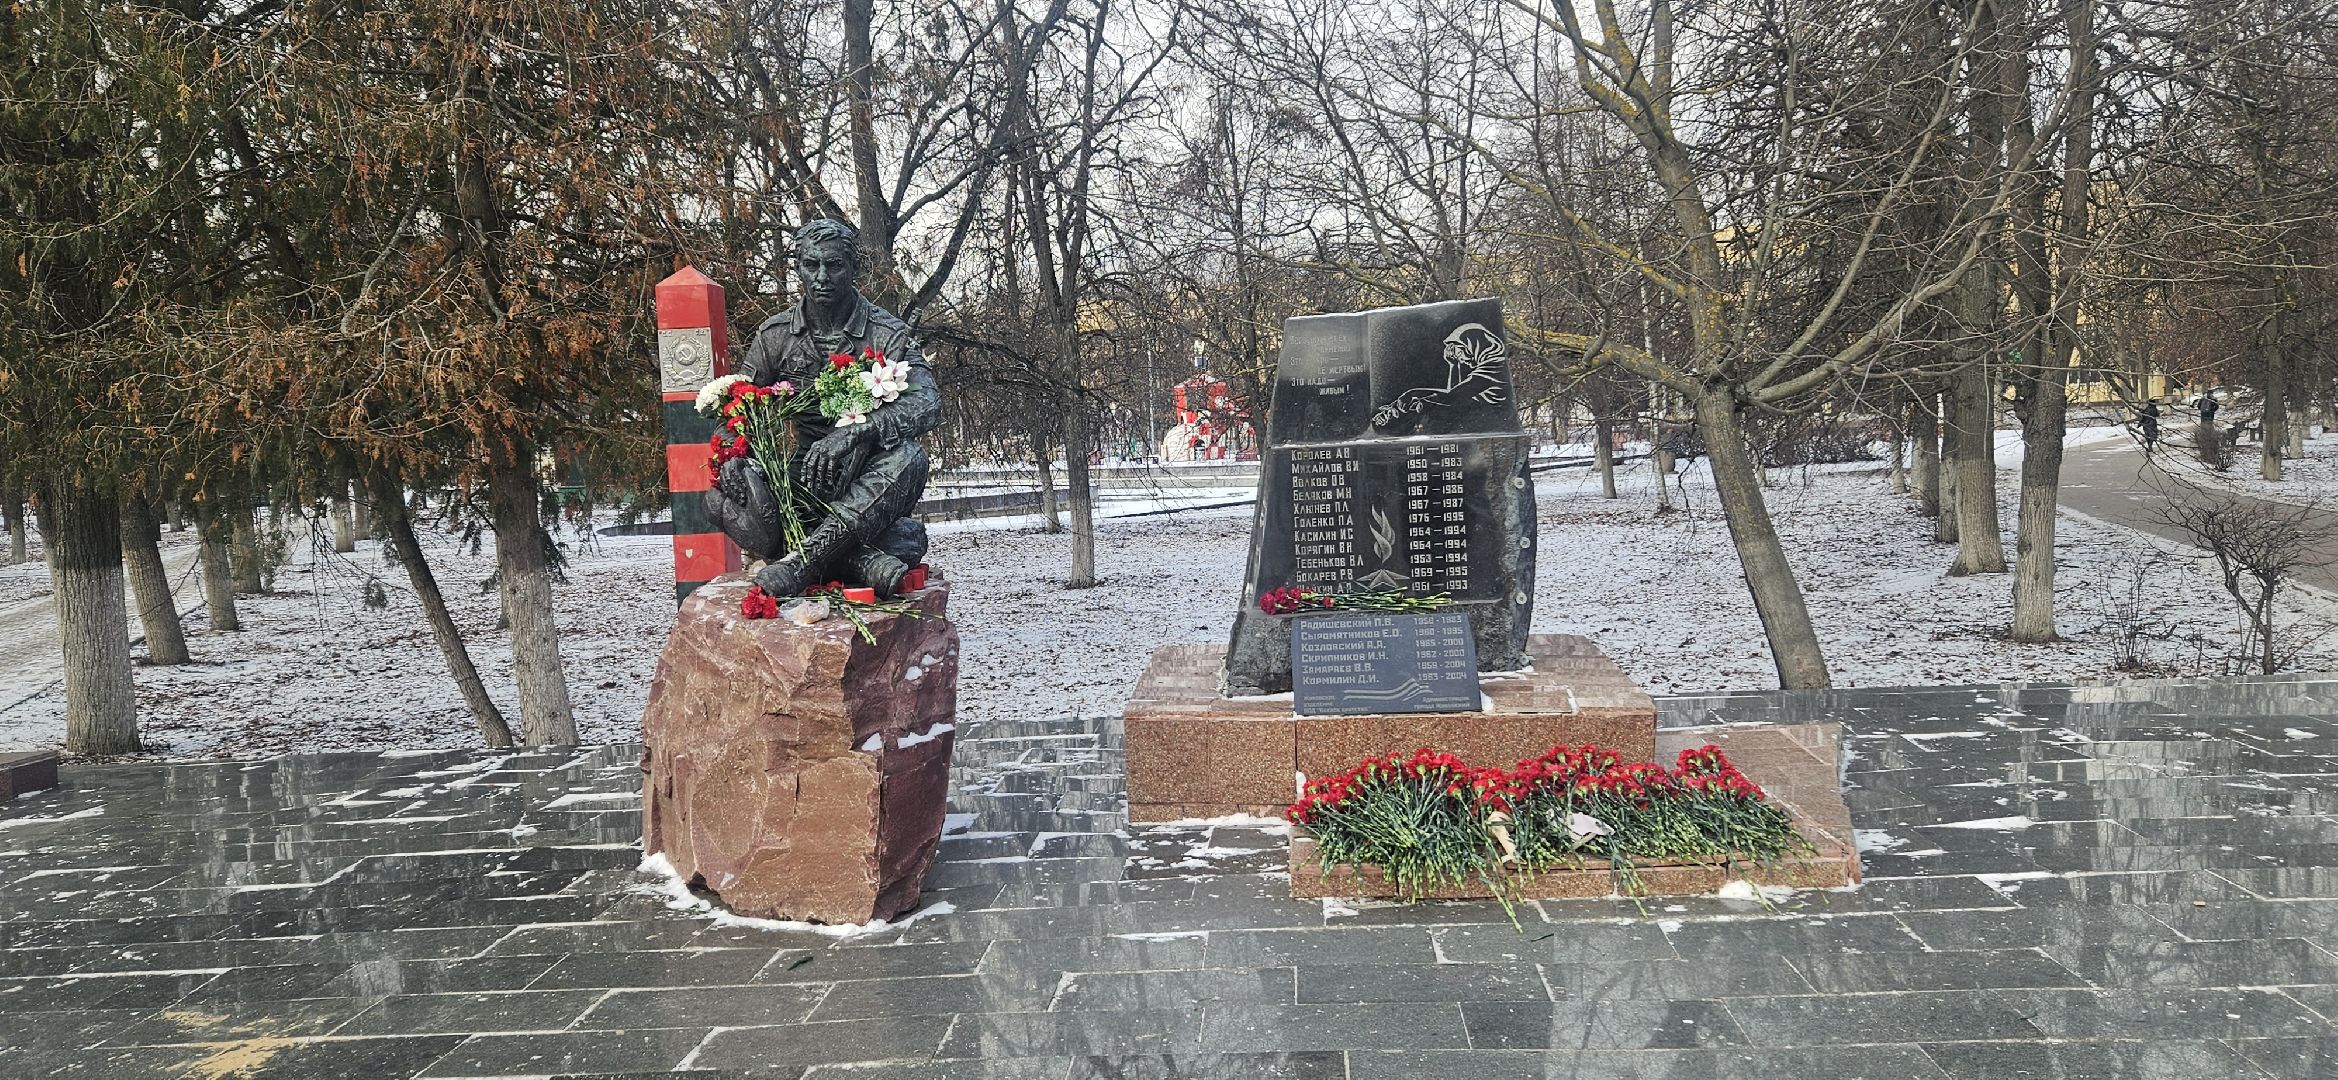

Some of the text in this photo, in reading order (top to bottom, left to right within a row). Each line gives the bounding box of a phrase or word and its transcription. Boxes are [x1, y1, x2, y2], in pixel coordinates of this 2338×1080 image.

[1443, 638, 1464, 646] 2000
[1443, 649, 1465, 657] 2000
[1444, 660, 1466, 668] 2004
[1445, 671, 1467, 680] 2004
